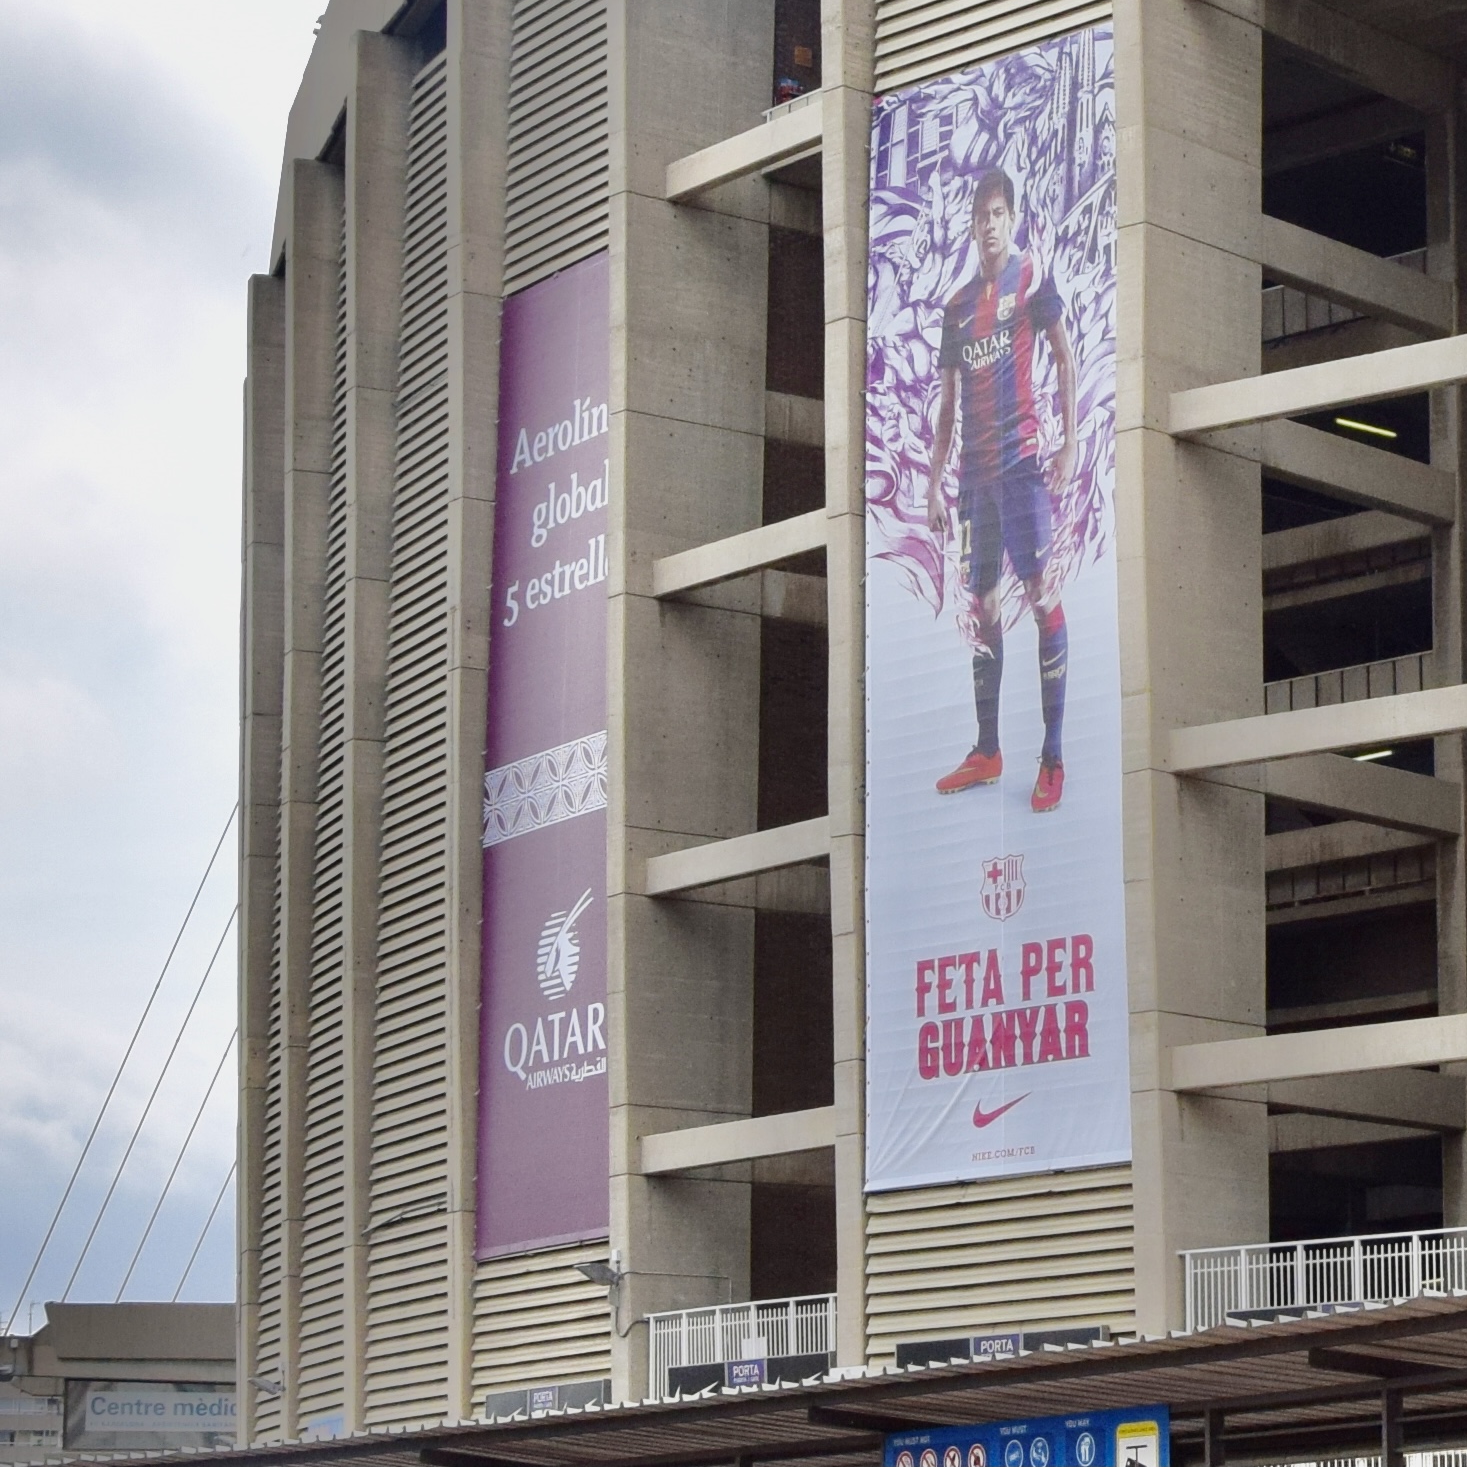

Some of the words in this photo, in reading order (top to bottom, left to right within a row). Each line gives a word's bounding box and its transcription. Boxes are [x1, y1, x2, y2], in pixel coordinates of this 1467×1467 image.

[962, 329, 1011, 363] QATAR
[970, 345, 1011, 371] AIRWAYS
[503, 580, 519, 627] 5
[916, 948, 1005, 1018] FETA
[1020, 933, 1095, 1002] PER
[504, 1003, 606, 1080] QATAR
[917, 999, 1091, 1080] GUANYAR
[526, 1064, 570, 1090] AIRWAYS
[971, 1146, 1036, 1162] NIKE.COM/FCB
[980, 1337, 1014, 1353] PORTA
[732, 1365, 760, 1378] PORTA
[90, 1396, 165, 1416] Centre
